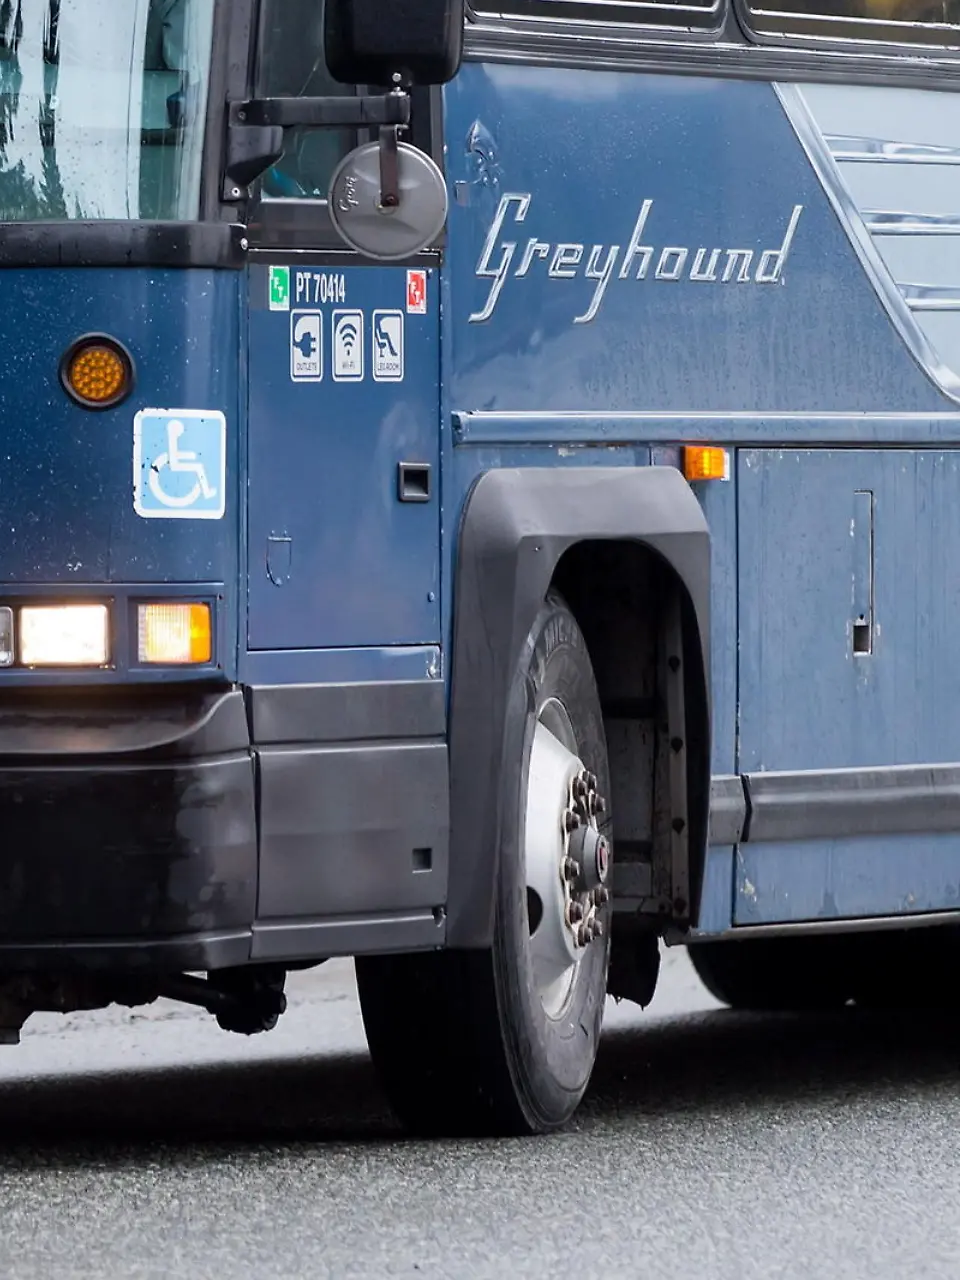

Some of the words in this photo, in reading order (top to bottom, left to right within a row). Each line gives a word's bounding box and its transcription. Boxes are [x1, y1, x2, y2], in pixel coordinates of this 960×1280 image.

[296, 271, 311, 303] PT
[313, 273, 346, 304] 70414
[467, 192, 803, 323] Greyhound
